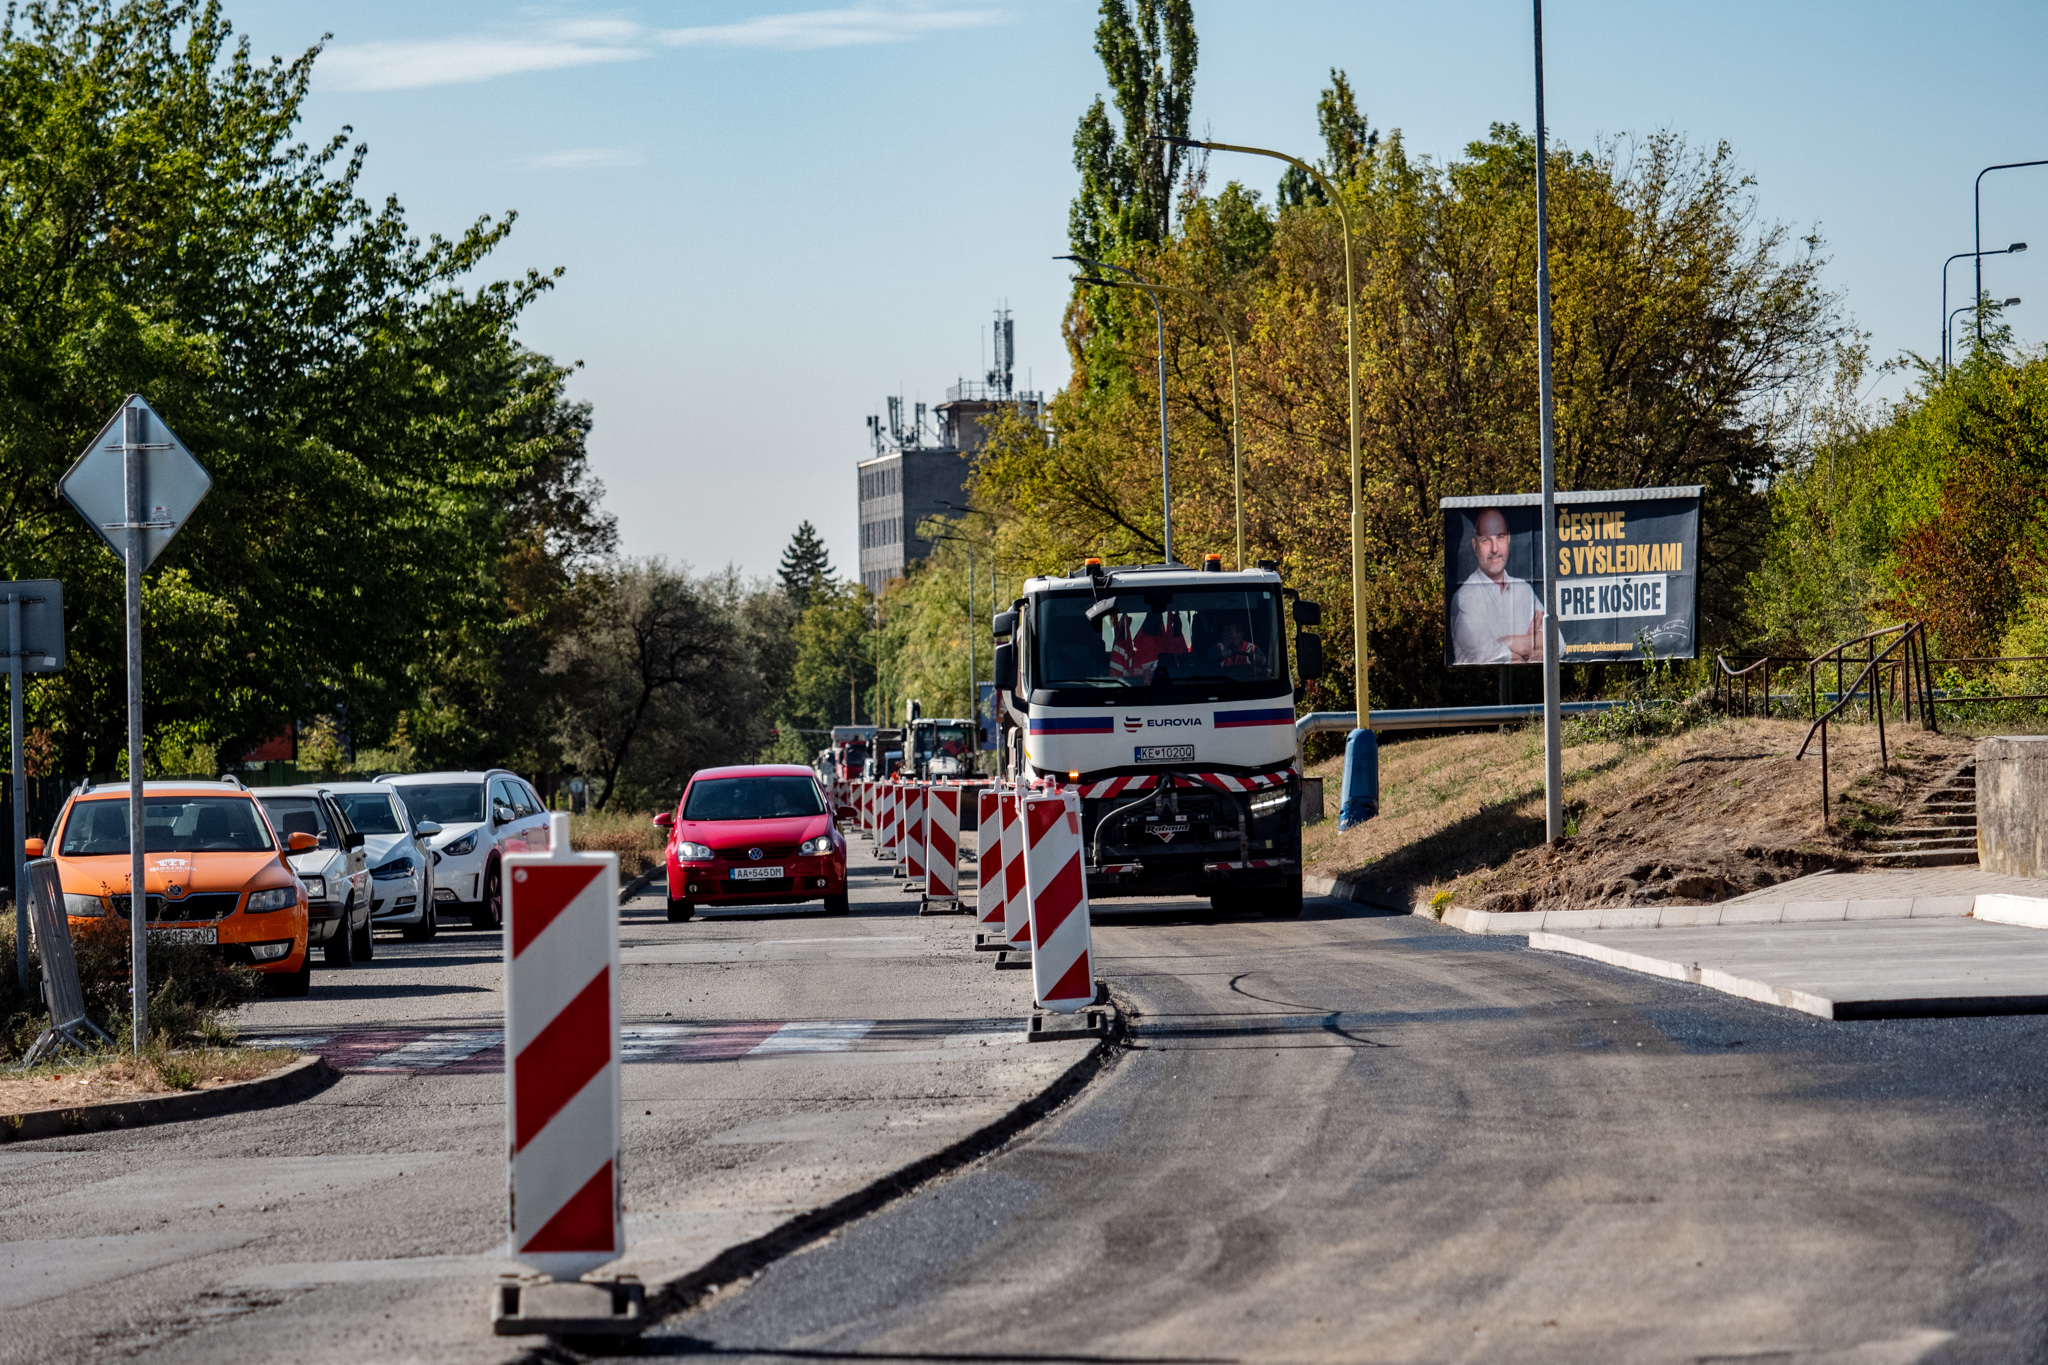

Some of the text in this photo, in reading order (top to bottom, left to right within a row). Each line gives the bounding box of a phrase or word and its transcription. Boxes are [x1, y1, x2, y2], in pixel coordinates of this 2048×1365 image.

[1558, 508, 1625, 541] ČESTNE
[1559, 541, 1682, 575] S VÝSLEDKAMI
[1560, 578, 1662, 616] PRE KOŠICE
[1147, 718, 1202, 727] EUROVIA
[1145, 824, 1190, 834] Rabaud
